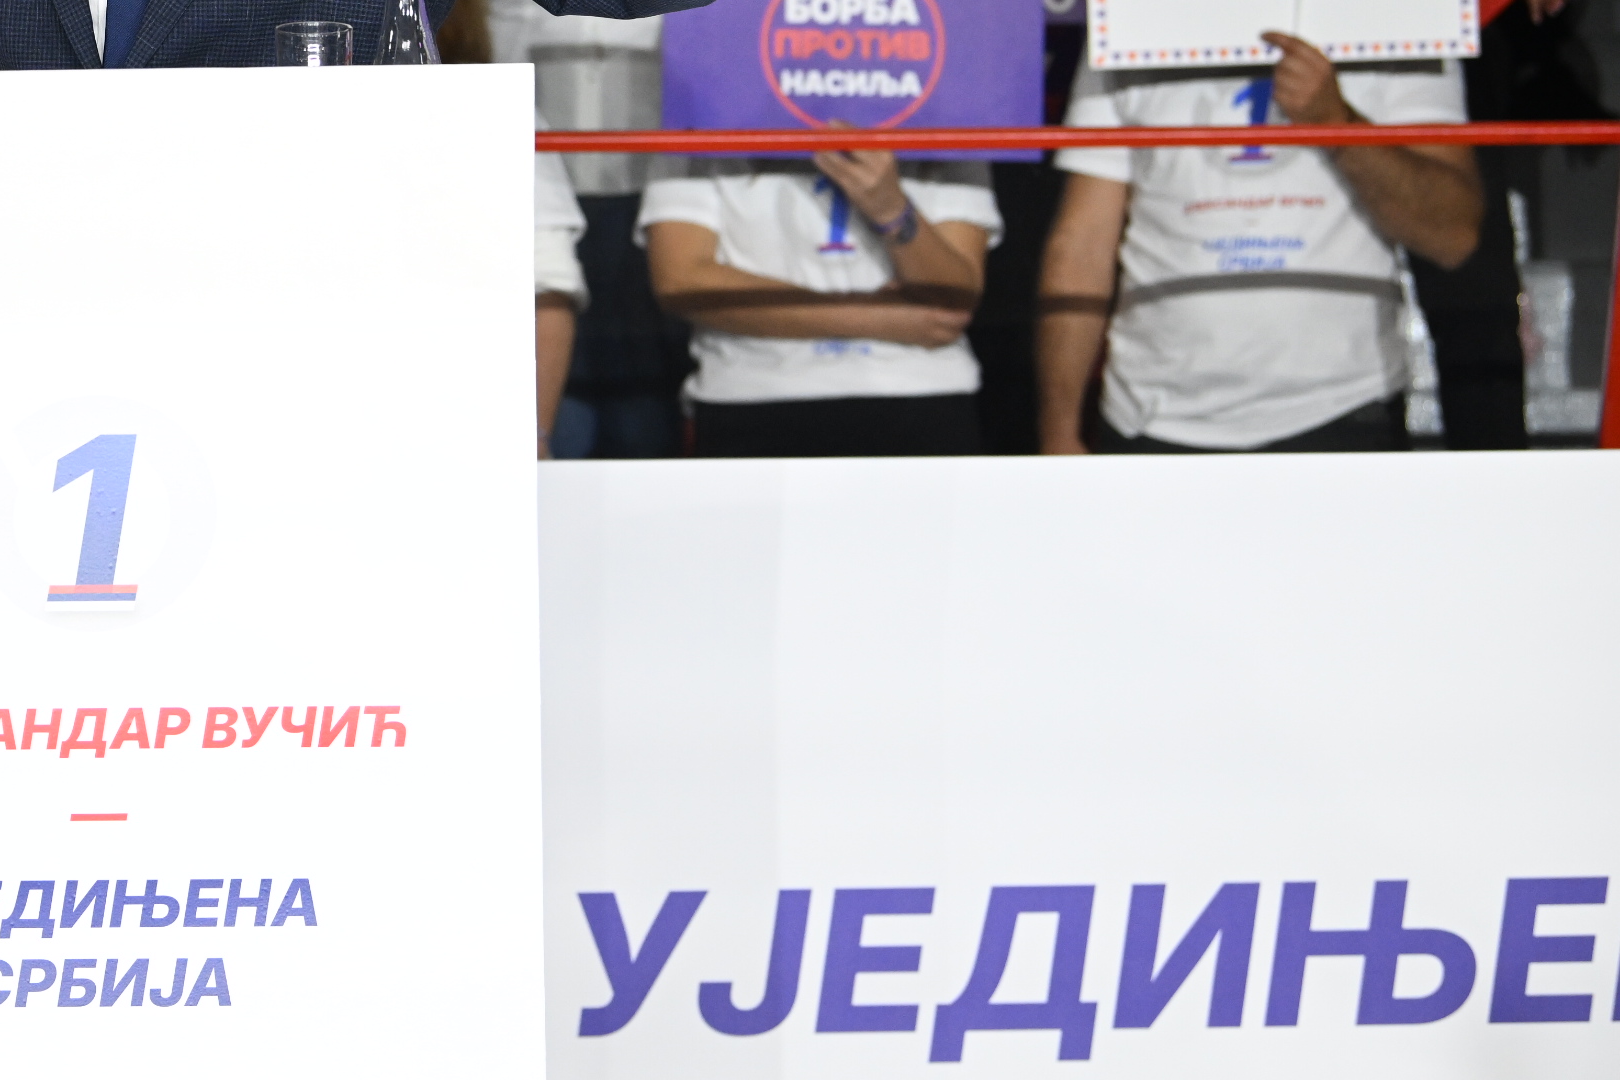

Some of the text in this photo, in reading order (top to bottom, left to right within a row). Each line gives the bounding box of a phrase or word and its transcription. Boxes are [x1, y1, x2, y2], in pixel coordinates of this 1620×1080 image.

[774, 28, 931, 60] ПРОТИВ
[780, 69, 923, 98] НАСИЉА
[46, 434, 139, 603] 1
[201, 705, 408, 749] ВУЧИЋ
[576, 875, 1620, 1064] УЈЕДИЊЕ
